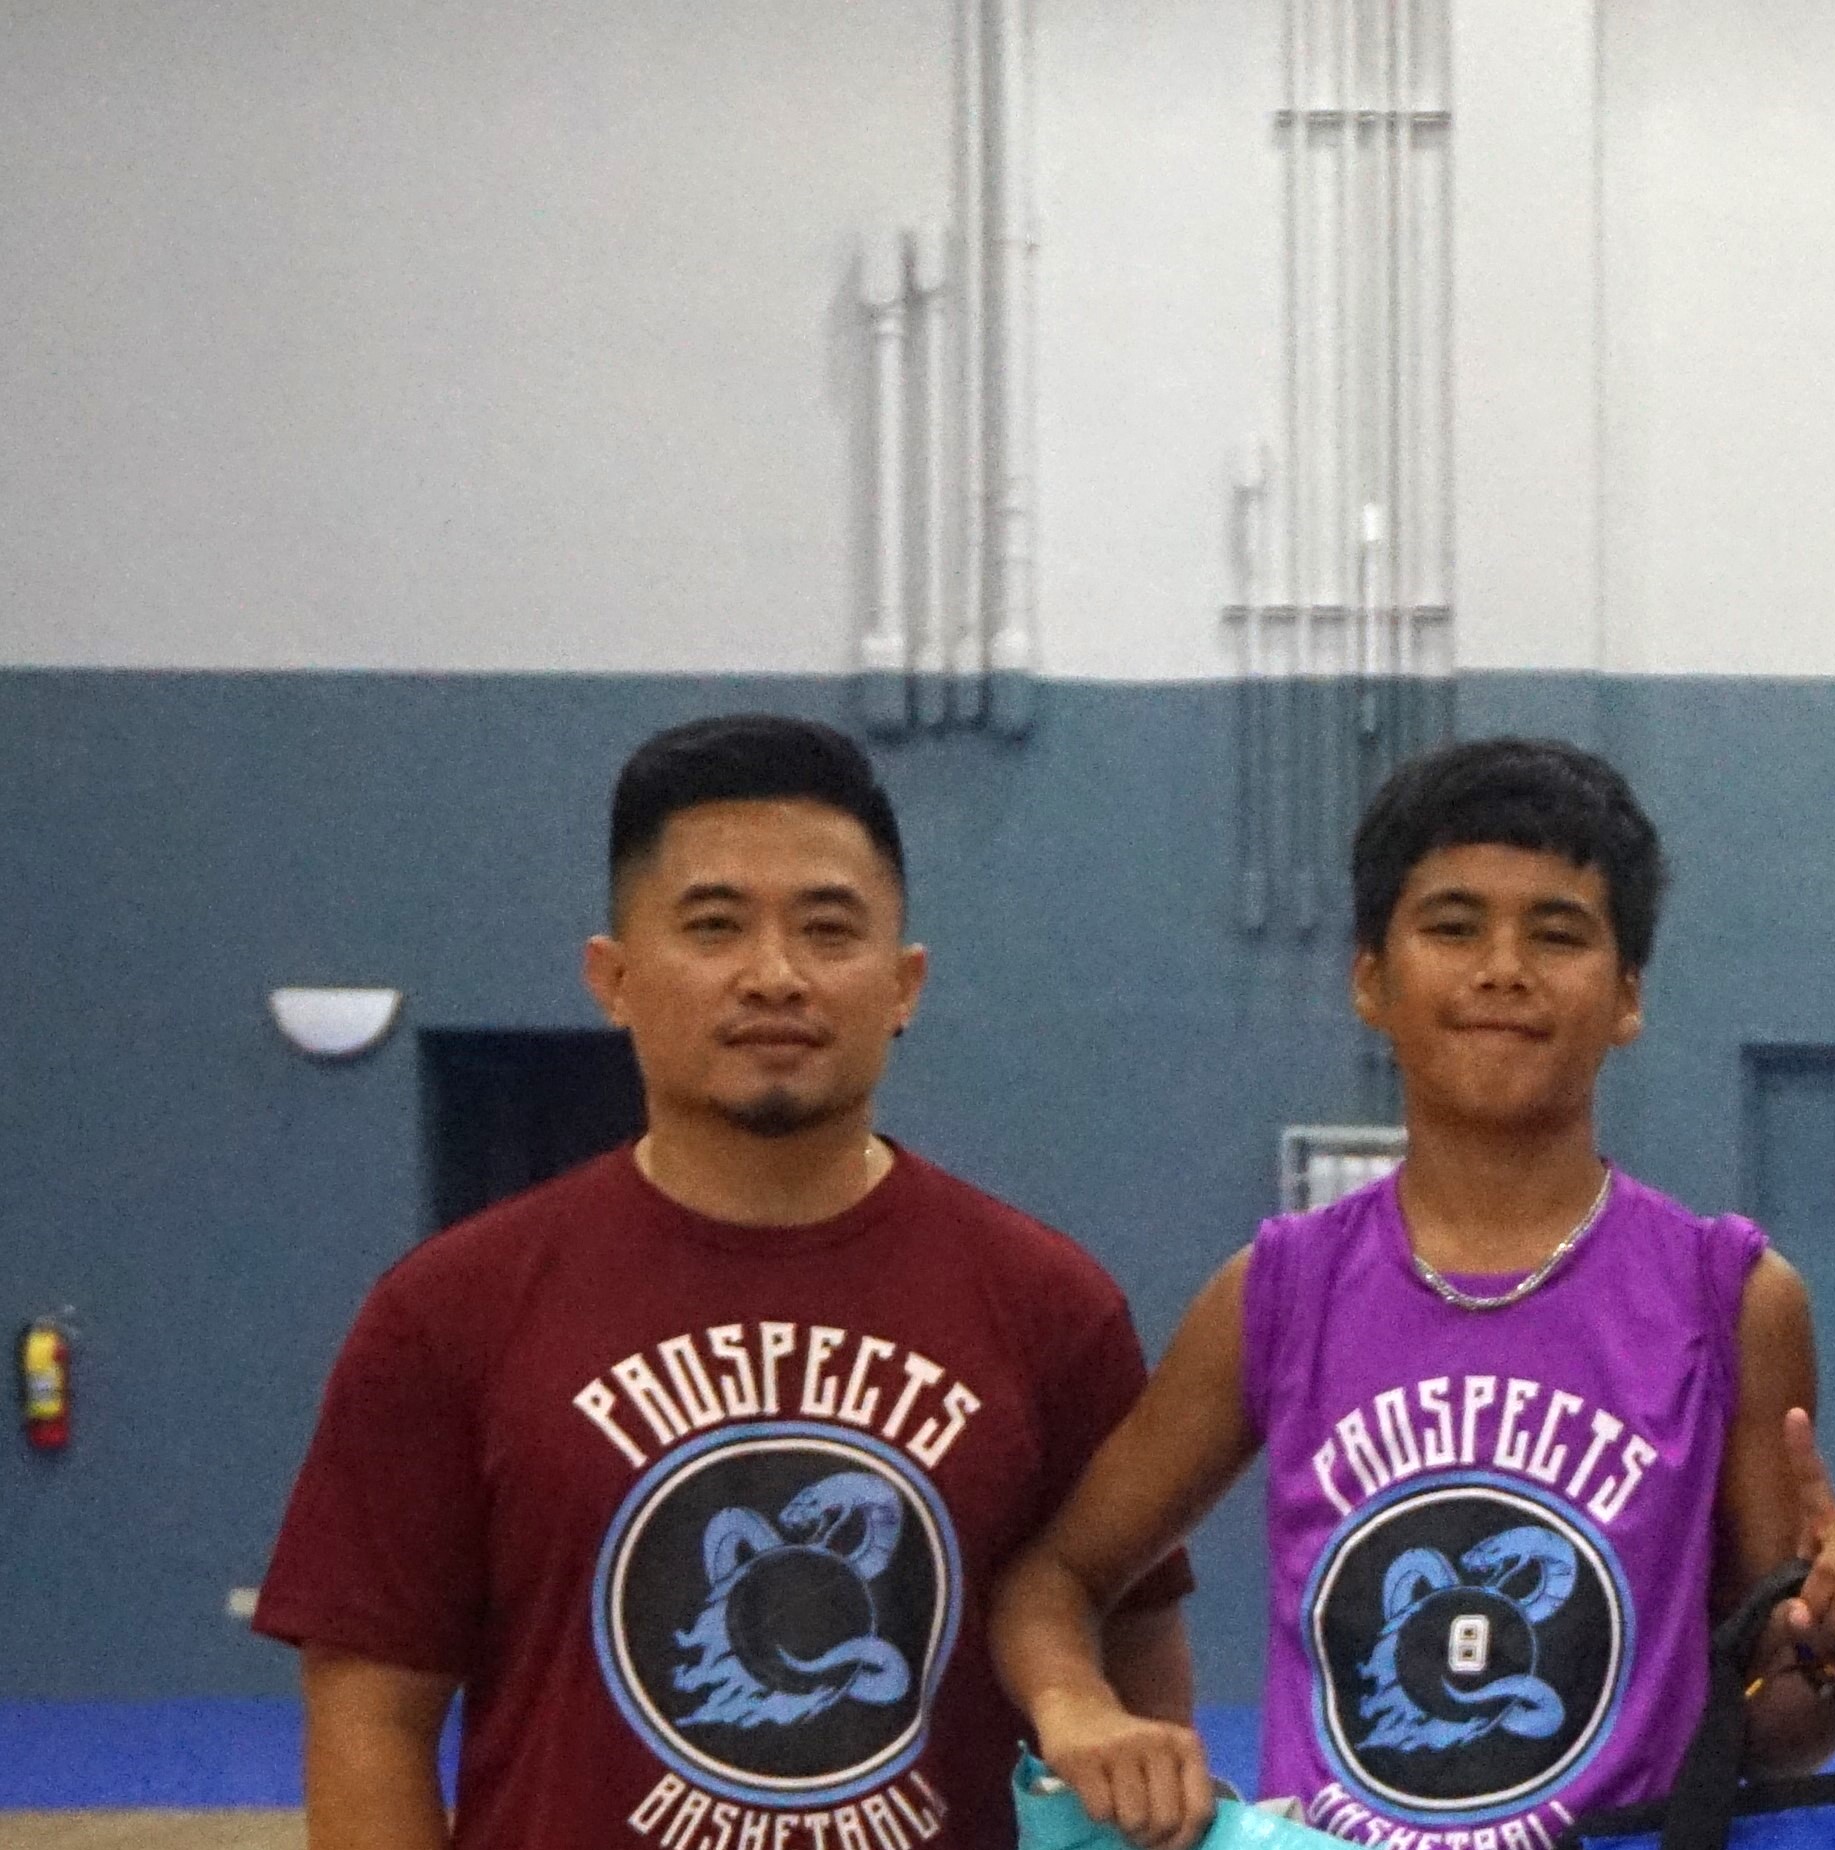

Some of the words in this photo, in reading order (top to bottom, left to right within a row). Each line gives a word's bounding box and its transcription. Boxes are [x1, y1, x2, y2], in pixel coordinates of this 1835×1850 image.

[573, 1321, 981, 1469] PROSPECTS
[1313, 1374, 1658, 1523] PROSPECTS
[1448, 1613, 1490, 1672] 8
